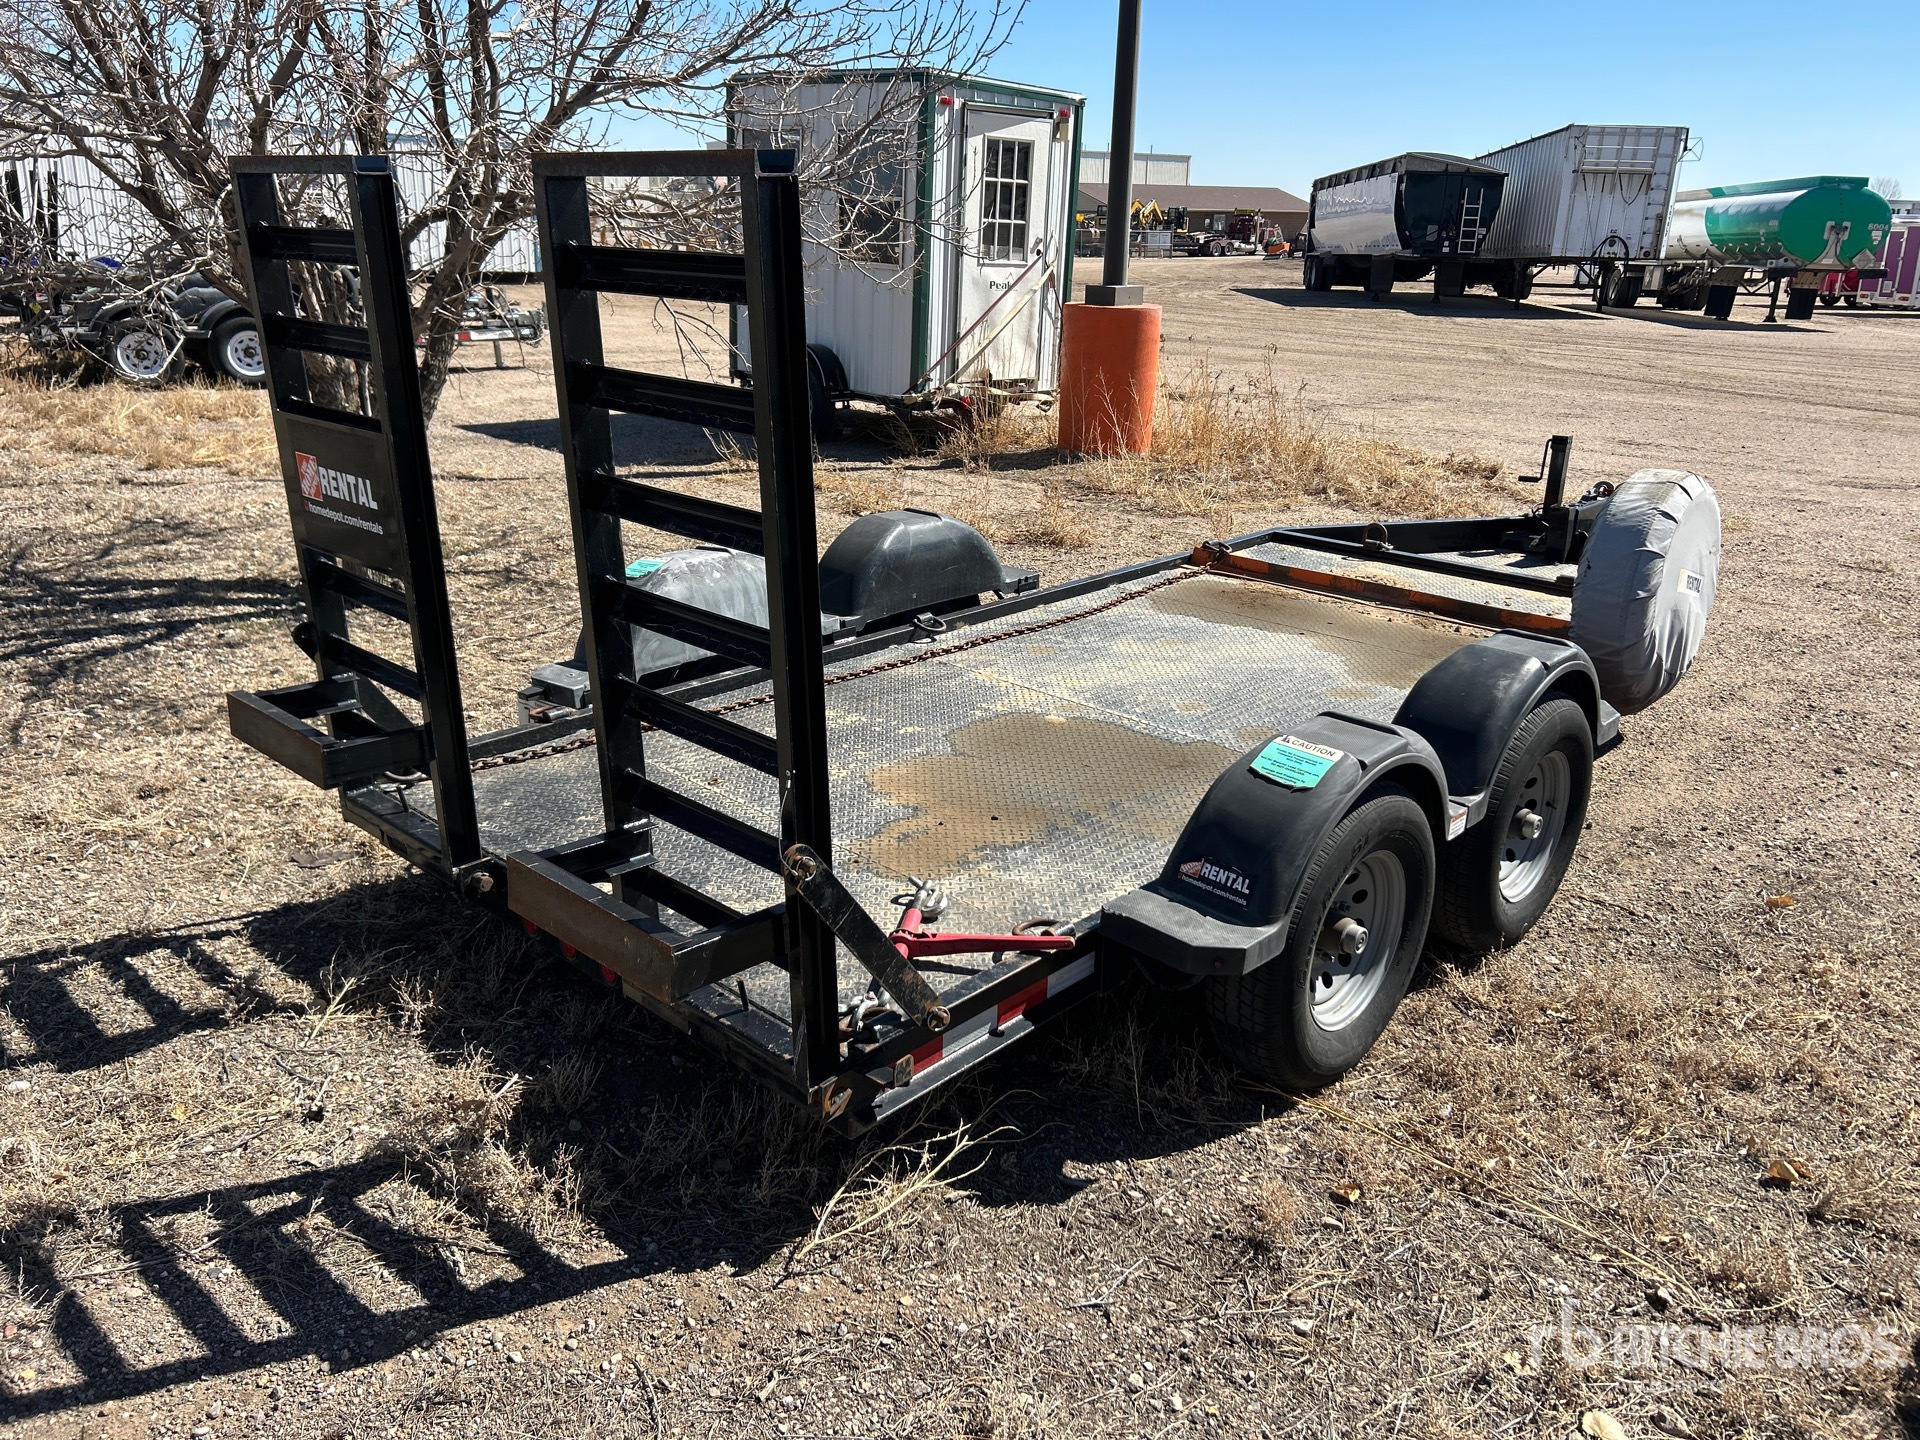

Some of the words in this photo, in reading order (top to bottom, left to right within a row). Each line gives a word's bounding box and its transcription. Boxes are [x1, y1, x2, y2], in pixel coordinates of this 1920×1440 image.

[1867, 223, 1889, 232] 8004
[318, 466, 378, 510] RENTAL
[308, 501, 384, 535] homedepot.com/rentals
[1292, 740, 1336, 757] CAUTION
[1200, 862, 1250, 894] RENTAL
